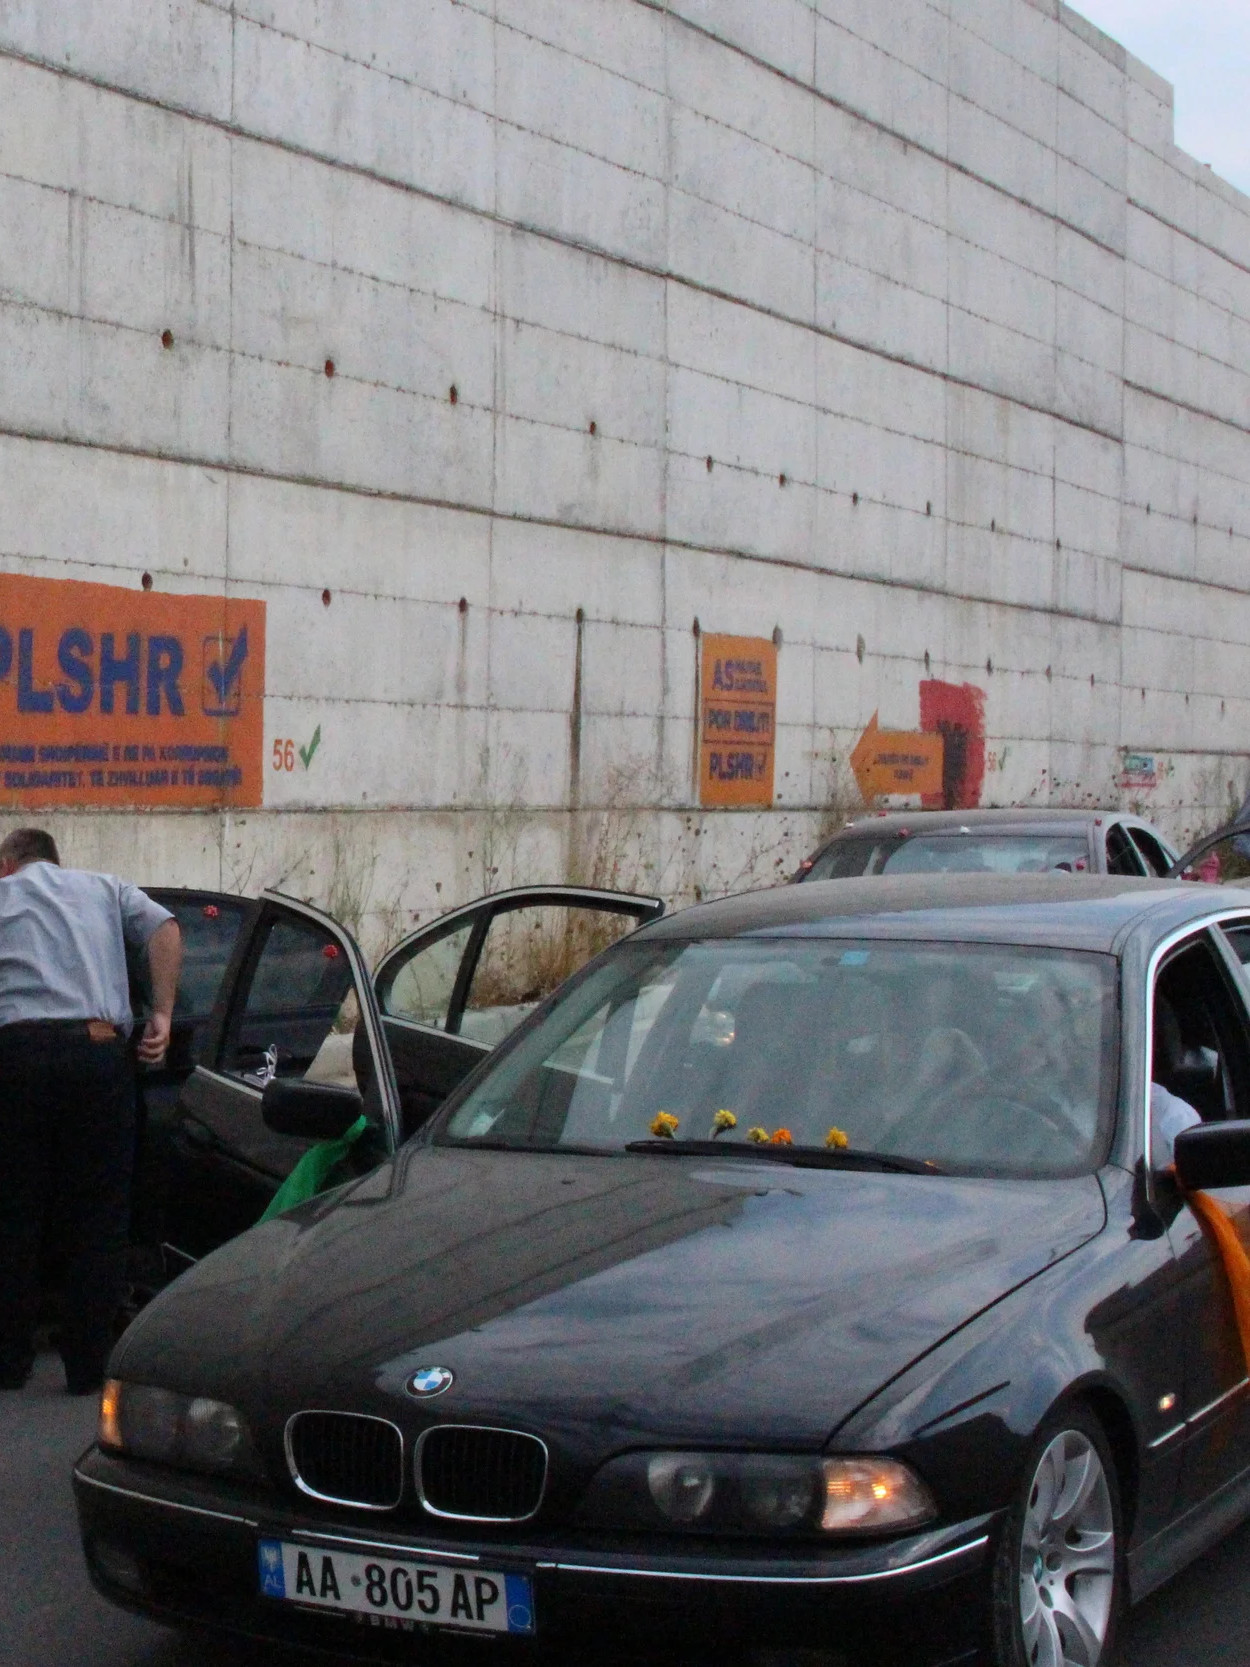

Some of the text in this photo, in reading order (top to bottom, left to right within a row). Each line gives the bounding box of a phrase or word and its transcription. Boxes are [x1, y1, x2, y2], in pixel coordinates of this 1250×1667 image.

[272, 738, 295, 772] 56
[708, 751, 753, 780] PLSHR
[264, 1574, 282, 1589] AL
[296, 1550, 500, 1622] AA 805 AP
